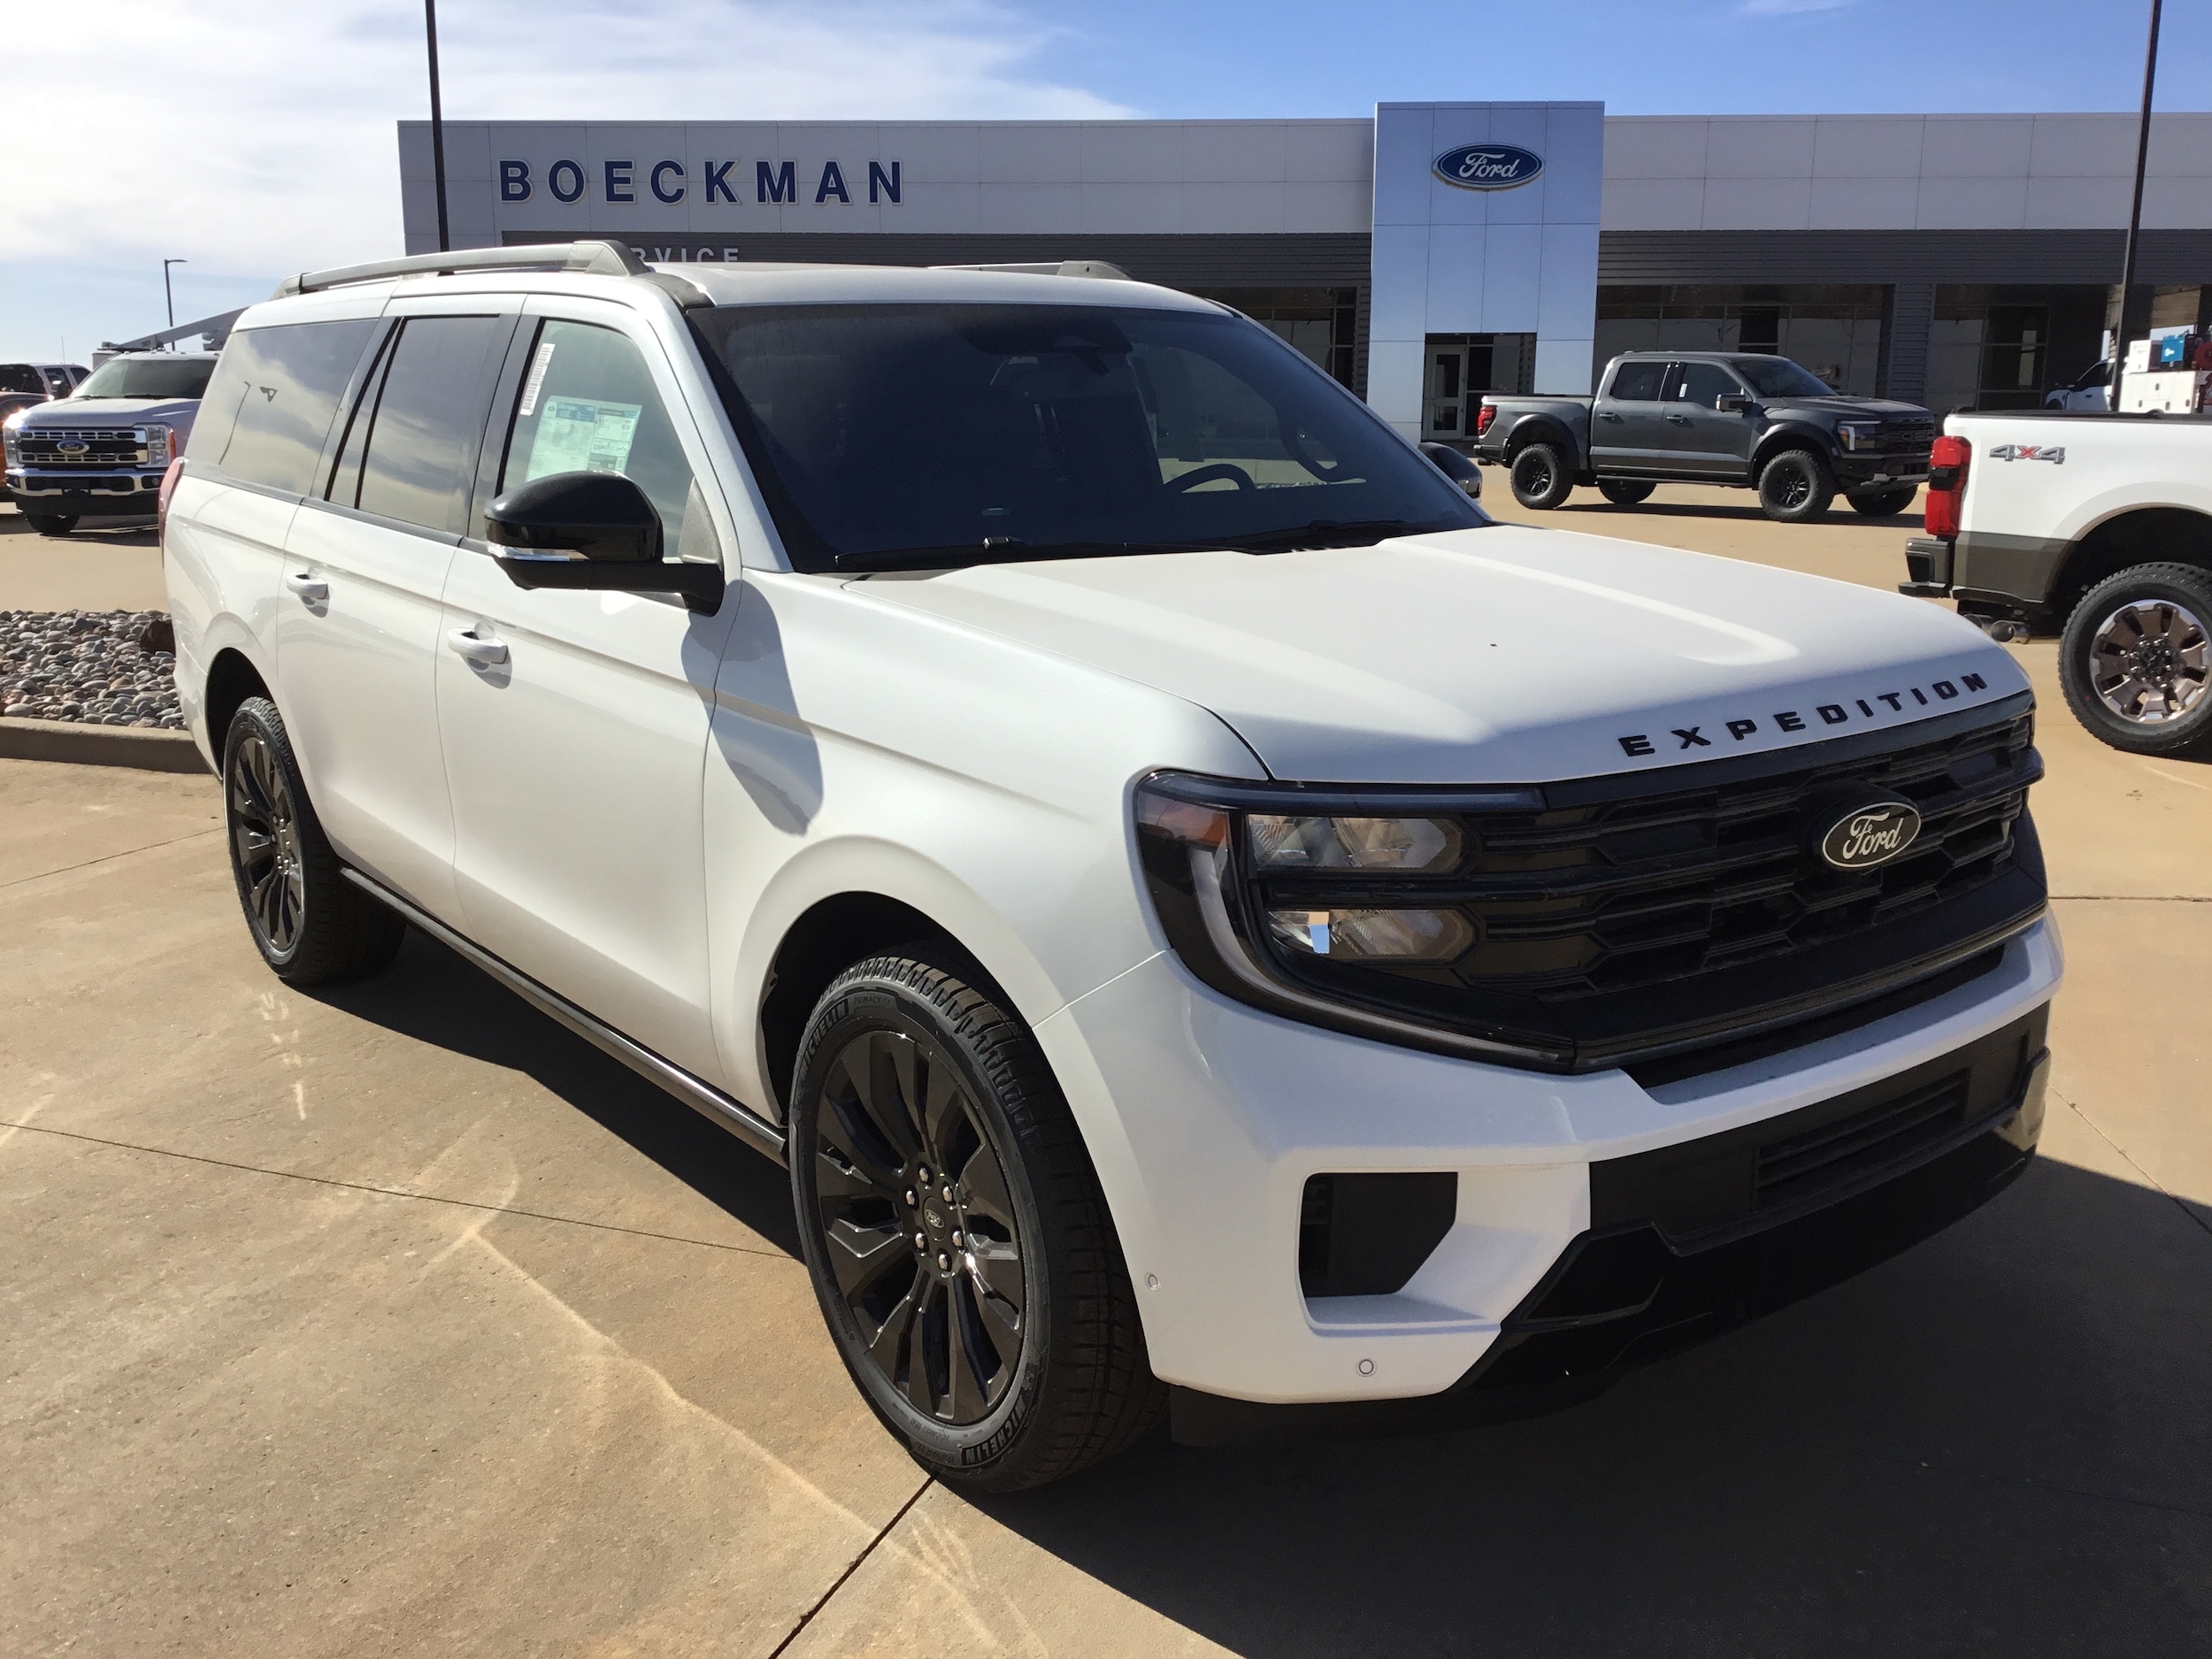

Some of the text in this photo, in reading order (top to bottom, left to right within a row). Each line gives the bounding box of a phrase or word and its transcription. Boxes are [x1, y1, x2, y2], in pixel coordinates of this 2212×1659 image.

[499, 159, 903, 204] BOECKMAN
[1458, 152, 1520, 178] Ford
[630, 247, 739, 262] RVICE
[1617, 672, 1989, 757] EXPEDITION
[1842, 811, 1905, 860] Ford
[798, 1000, 847, 1084] MICHELIN
[964, 1394, 1026, 1463] MICHELIN
